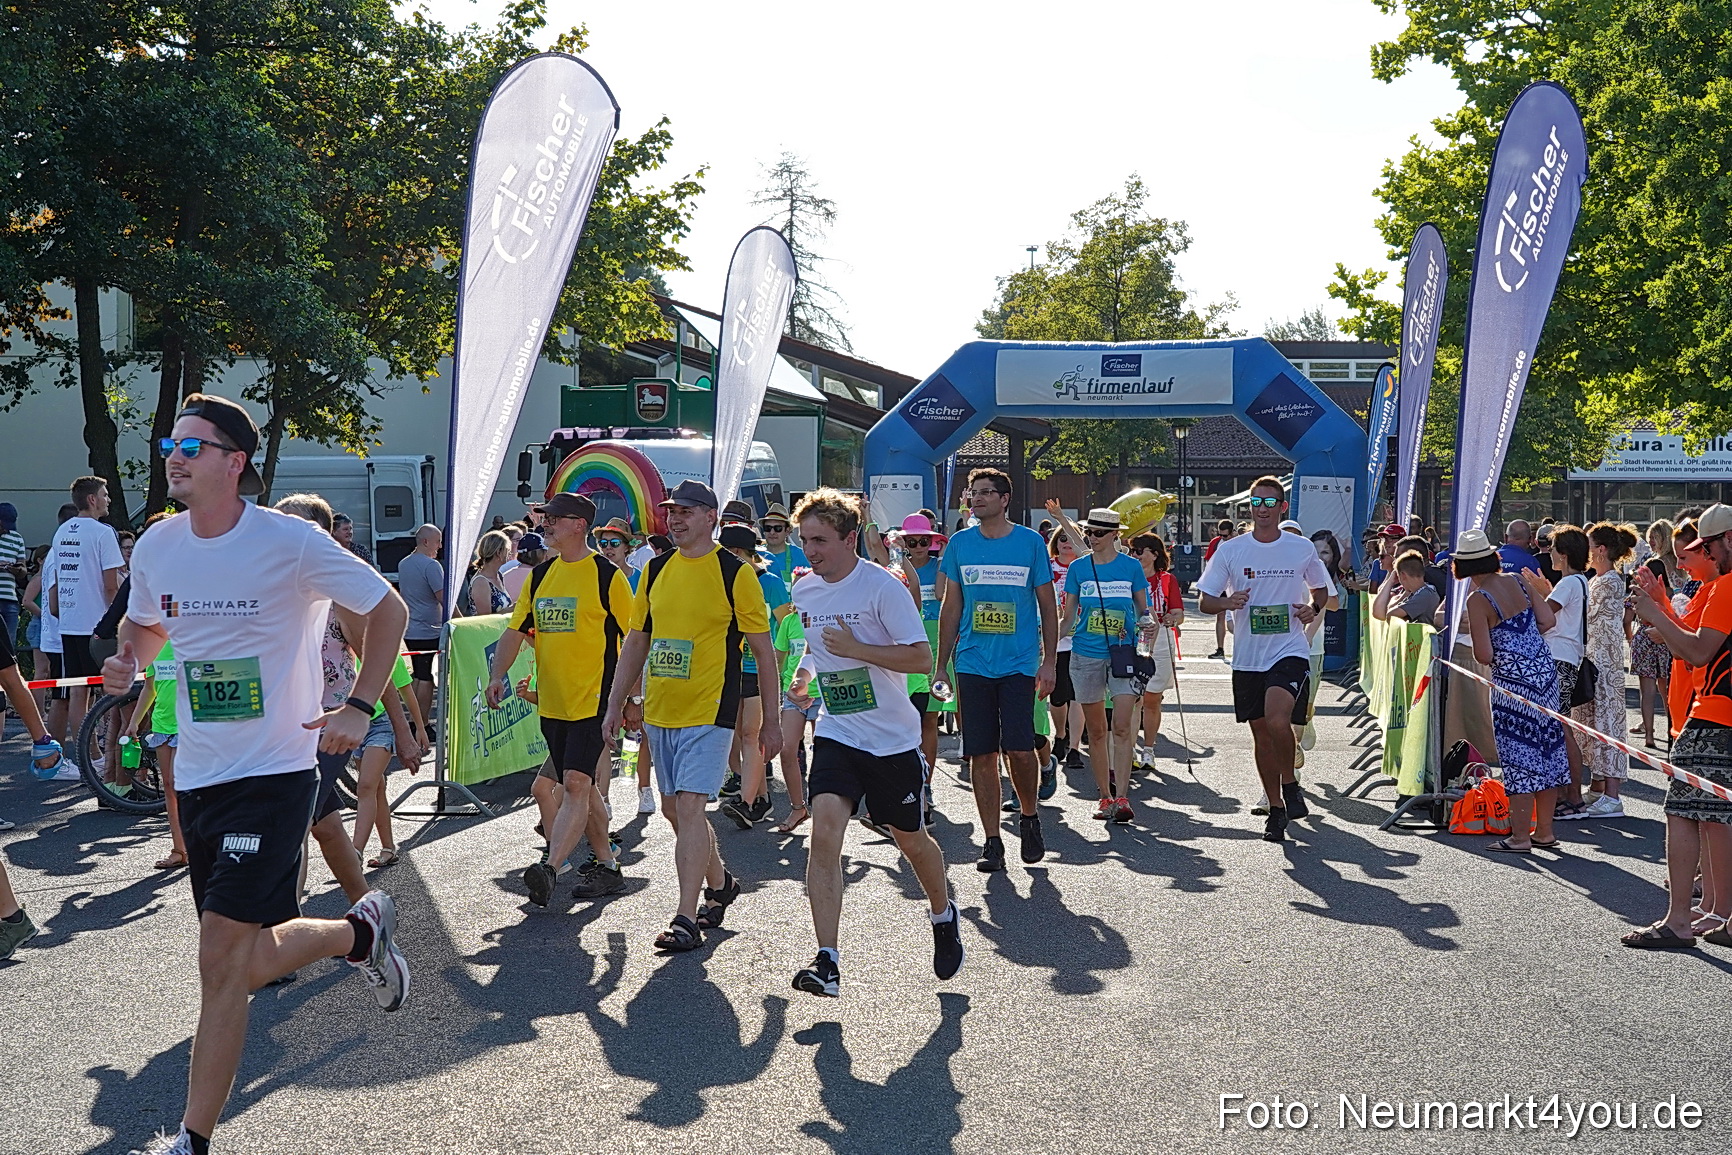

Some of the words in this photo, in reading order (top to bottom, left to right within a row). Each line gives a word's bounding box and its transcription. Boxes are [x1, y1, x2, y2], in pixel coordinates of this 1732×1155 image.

[511, 93, 575, 236] Fischer
[543, 114, 588, 230] AUTOMOBILE
[1510, 125, 1561, 266] Fischer
[1532, 149, 1569, 262] AUTOMOBILE
[743, 254, 776, 348] Fischer
[759, 268, 783, 344] AUTOMOBILE
[1415, 250, 1436, 348] Fischer
[1424, 265, 1440, 344] AUTOMOBILE
[1087, 377, 1175, 394] firmenlauf
[466, 317, 541, 520] www.fischer-automobile.de
[918, 405, 965, 416] Fischer
[1261, 406, 1274, 414] und
[1384, 417, 1393, 434] Druck
[1683, 466, 1724, 474] angenehmen
[1701, 458, 1719, 466] grüßt
[996, 569, 1025, 577] Grundschule
[182, 600, 260, 609] SCHWARZ
[541, 609, 569, 621] 1276
[980, 612, 1009, 624] 1433
[1094, 617, 1119, 629] 1432
[1260, 615, 1280, 625] 183
[654, 651, 682, 665] 1269
[191, 689, 200, 710] RUN
[204, 681, 241, 701] 182
[249, 682, 260, 710] 2022
[831, 684, 858, 701] 390
[863, 684, 874, 704] 2022
[491, 728, 514, 752] neumarkt
[223, 836, 261, 852] PUMA
